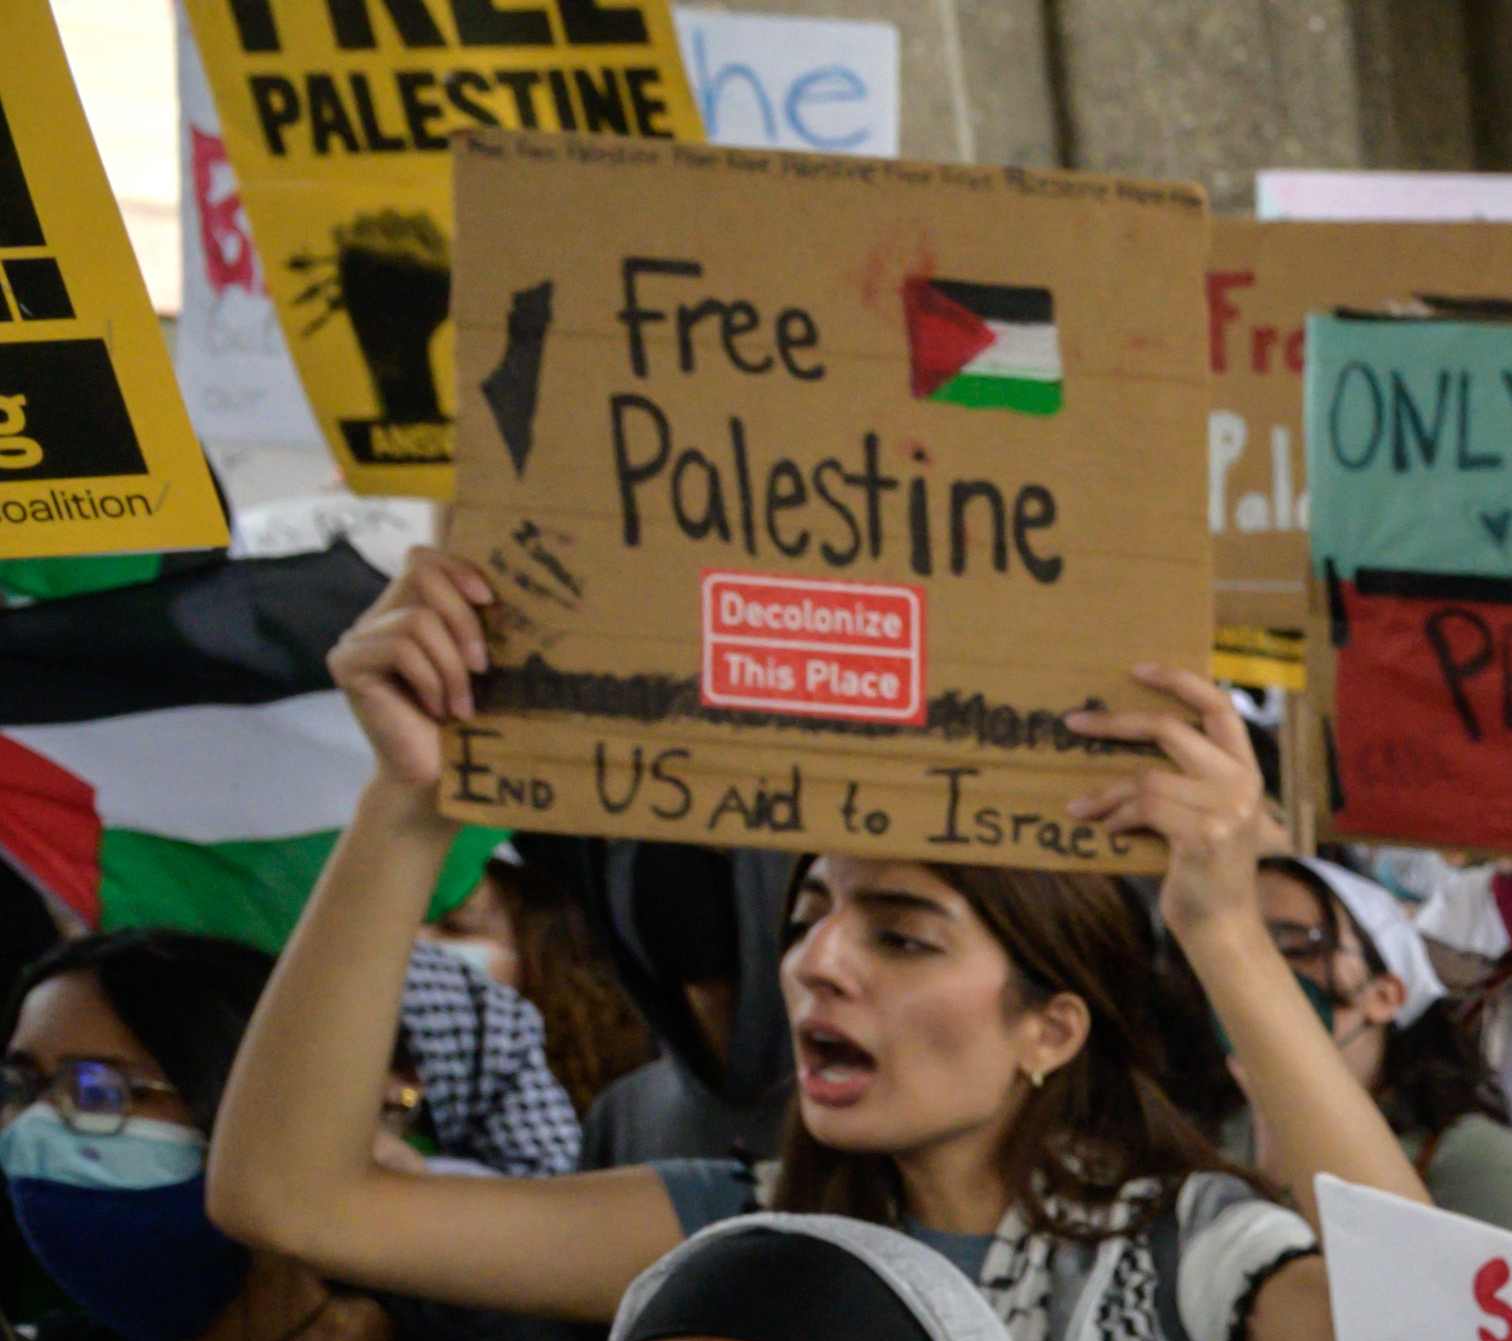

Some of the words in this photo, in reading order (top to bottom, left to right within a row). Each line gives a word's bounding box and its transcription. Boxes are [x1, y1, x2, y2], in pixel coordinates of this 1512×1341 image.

[247, 67, 674, 157] PALESTINE
[618, 255, 828, 382] Free
[608, 391, 1066, 586] Palestine
[719, 590, 905, 643] Decolonize
[724, 652, 796, 695] This
[805, 656, 903, 704] Place
[450, 727, 555, 813] END
[593, 741, 696, 820] US
[707, 762, 805, 836] Aid
[844, 782, 891, 837] to
